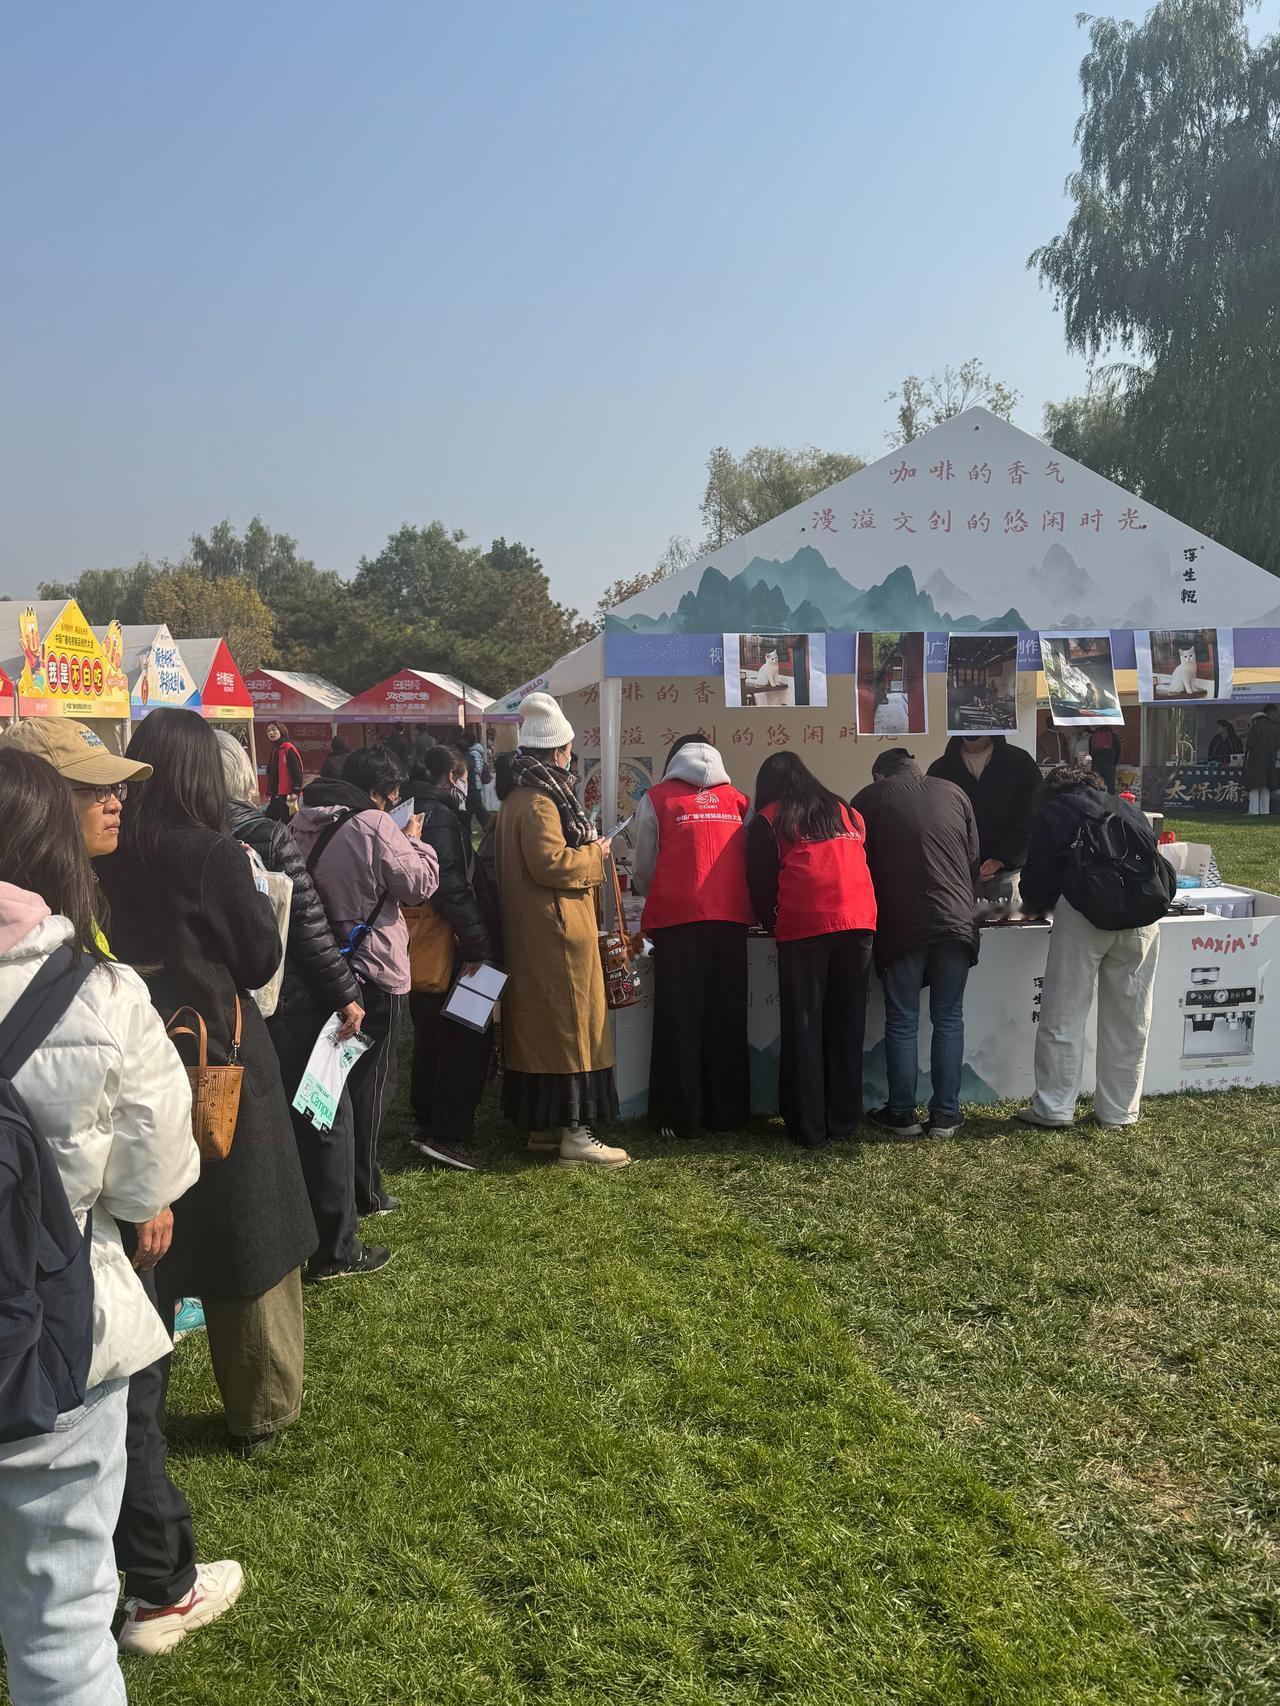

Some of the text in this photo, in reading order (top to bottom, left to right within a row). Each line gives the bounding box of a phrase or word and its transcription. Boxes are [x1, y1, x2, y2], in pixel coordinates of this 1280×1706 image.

[889, 459, 1065, 485] 咖啡的香气
[811, 507, 1146, 534] 漫溢文创的悠闲时光
[48, 660, 103, 688] 我是不白吃
[310, 1090, 334, 1121] Campus
